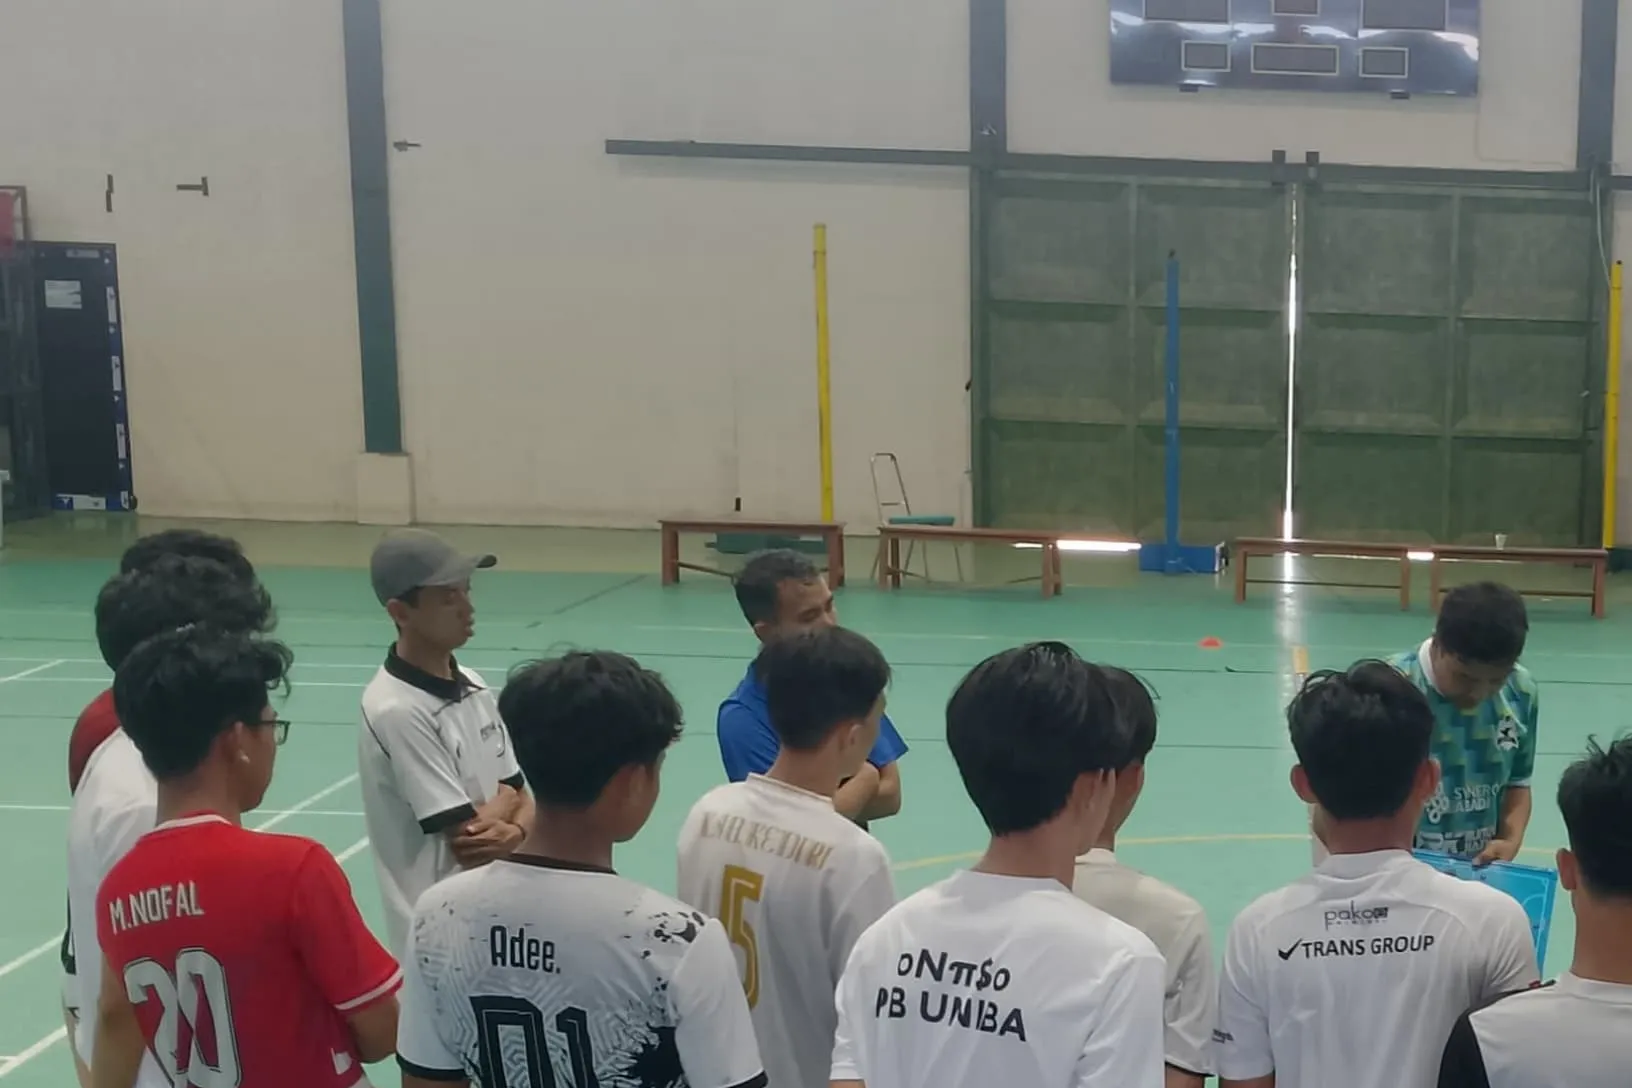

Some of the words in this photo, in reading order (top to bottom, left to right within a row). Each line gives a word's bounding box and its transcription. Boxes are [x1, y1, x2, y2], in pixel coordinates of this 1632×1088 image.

[109, 880, 205, 935] M.NOFAL
[490, 924, 561, 975] Adee.
[723, 864, 764, 1011] 5
[1300, 938, 1366, 959] TRANS
[1370, 934, 1435, 955] GROUP
[876, 986, 906, 1018] PB
